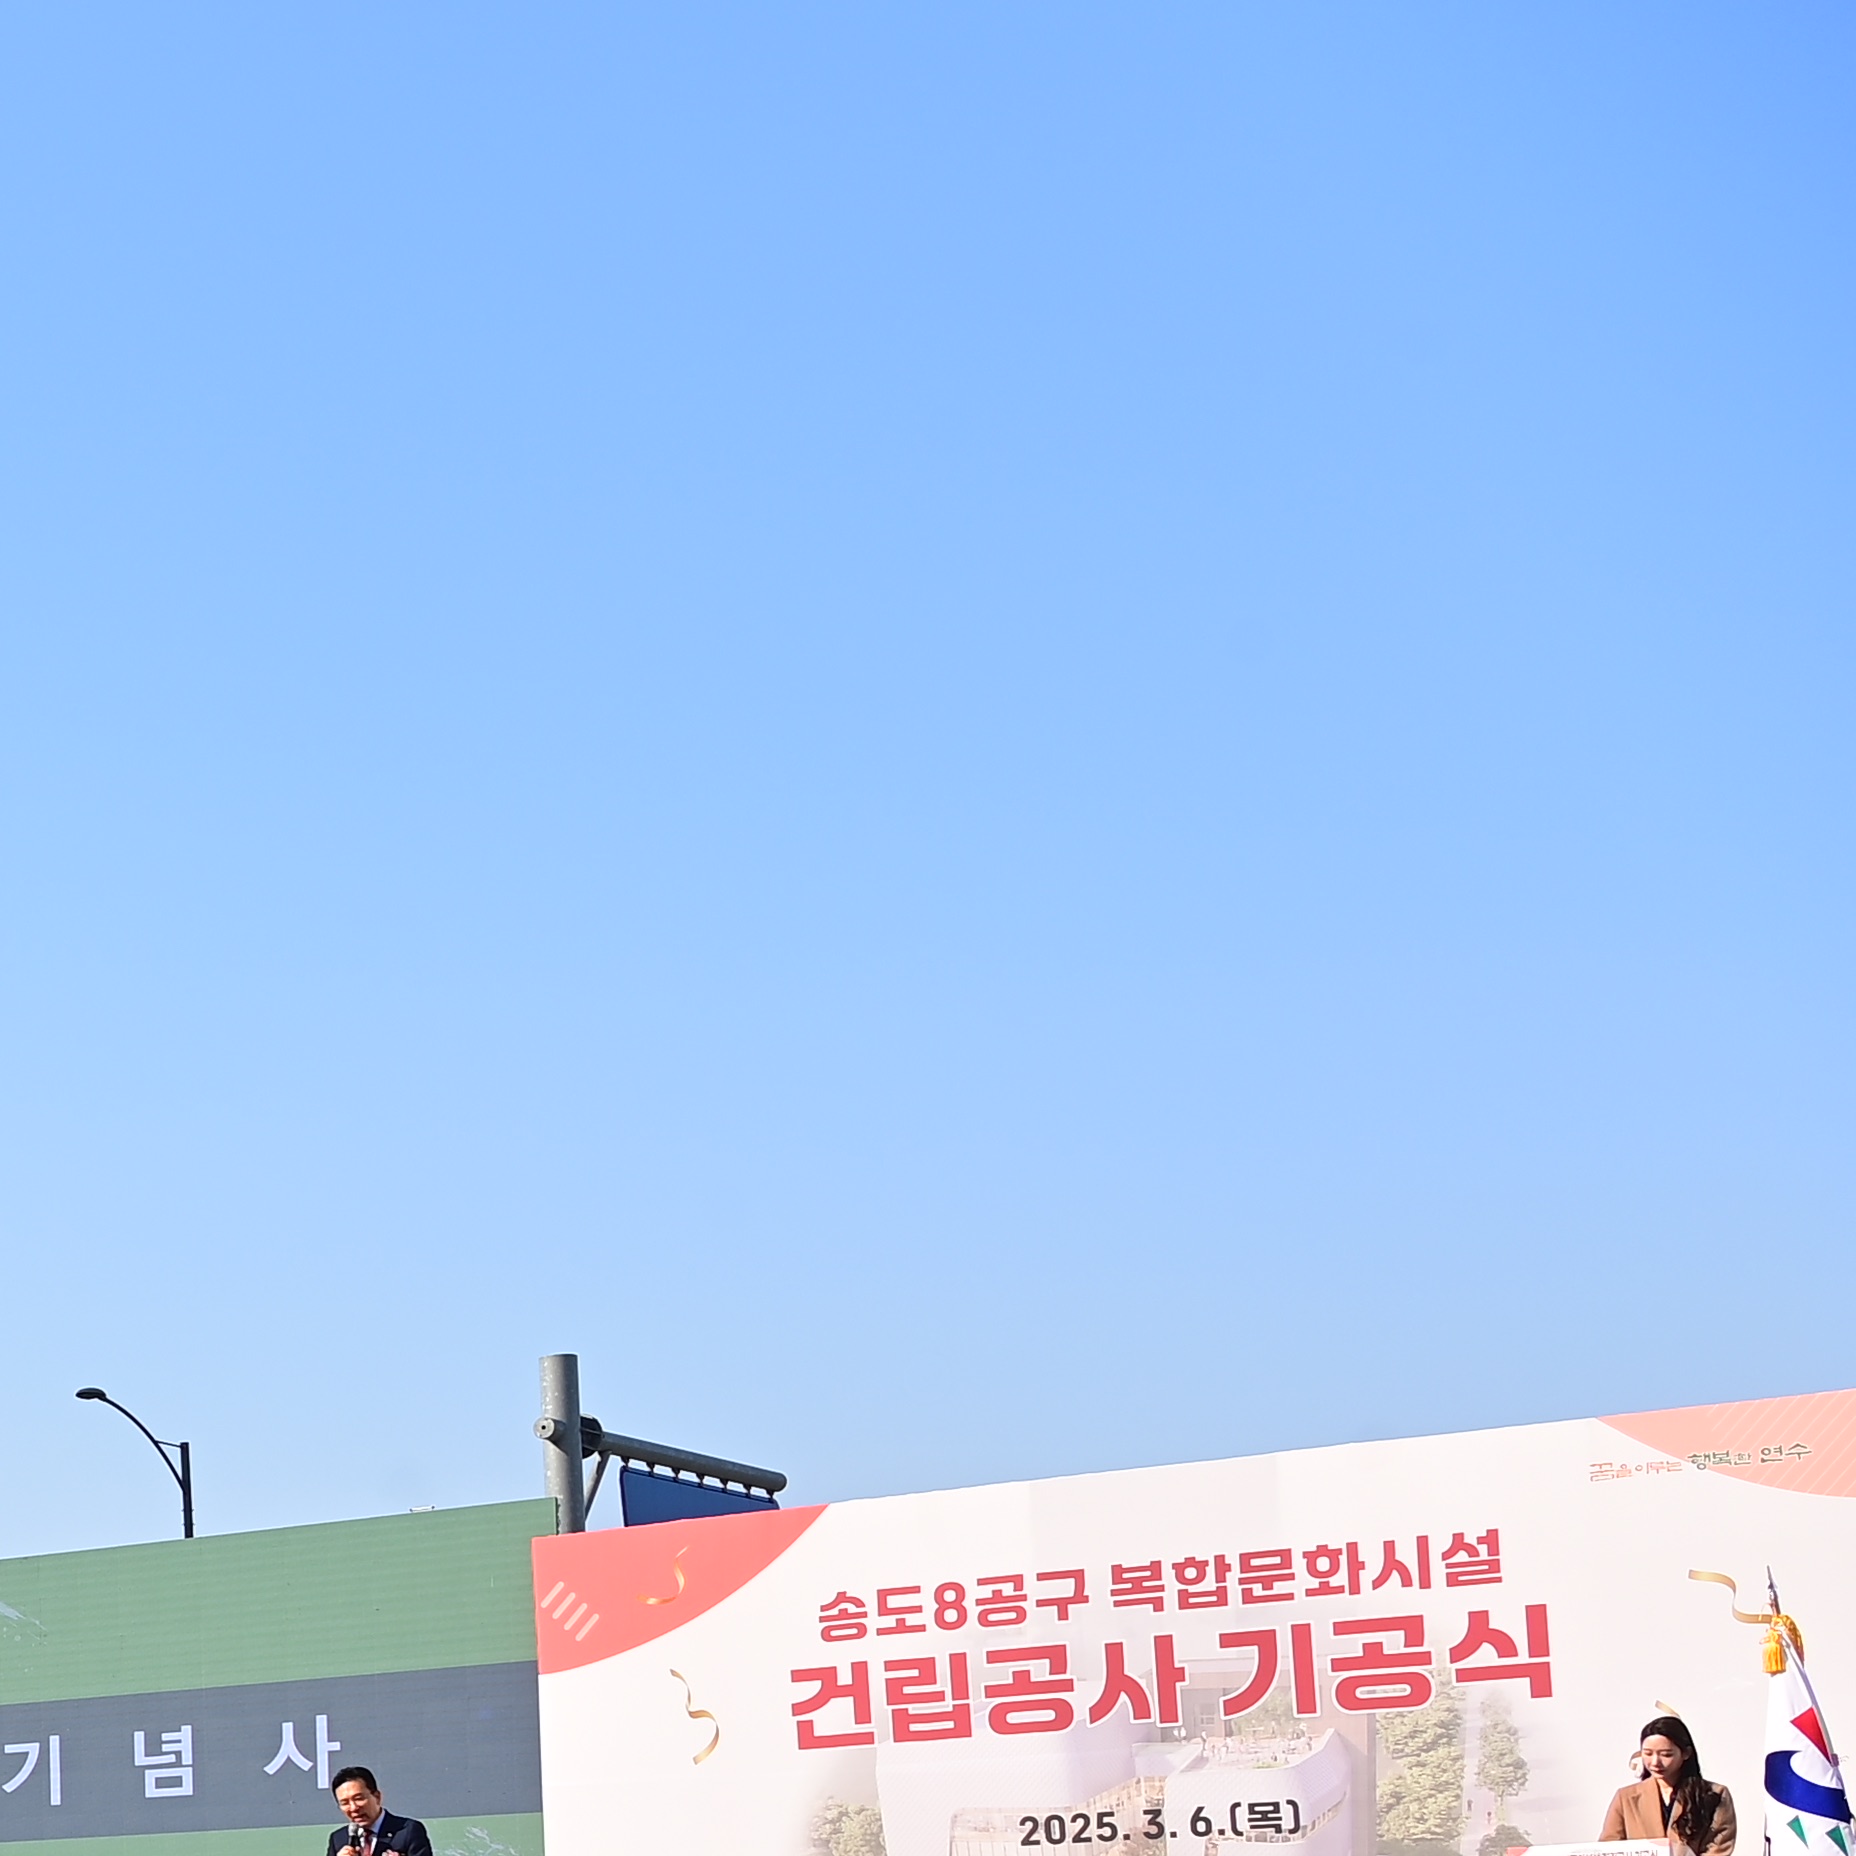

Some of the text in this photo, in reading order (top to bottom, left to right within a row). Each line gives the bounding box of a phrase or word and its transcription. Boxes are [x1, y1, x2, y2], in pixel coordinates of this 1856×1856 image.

[1687, 1450, 1752, 1471] 행복한
[1759, 1443, 1812, 1464] 연수
[818, 1527, 1504, 1643] 송도8공구 복합문화시설
[790, 1603, 1554, 1751] 건립공사 기공식
[1018, 1798, 1302, 1847] 2025. 3. 6.(목)
